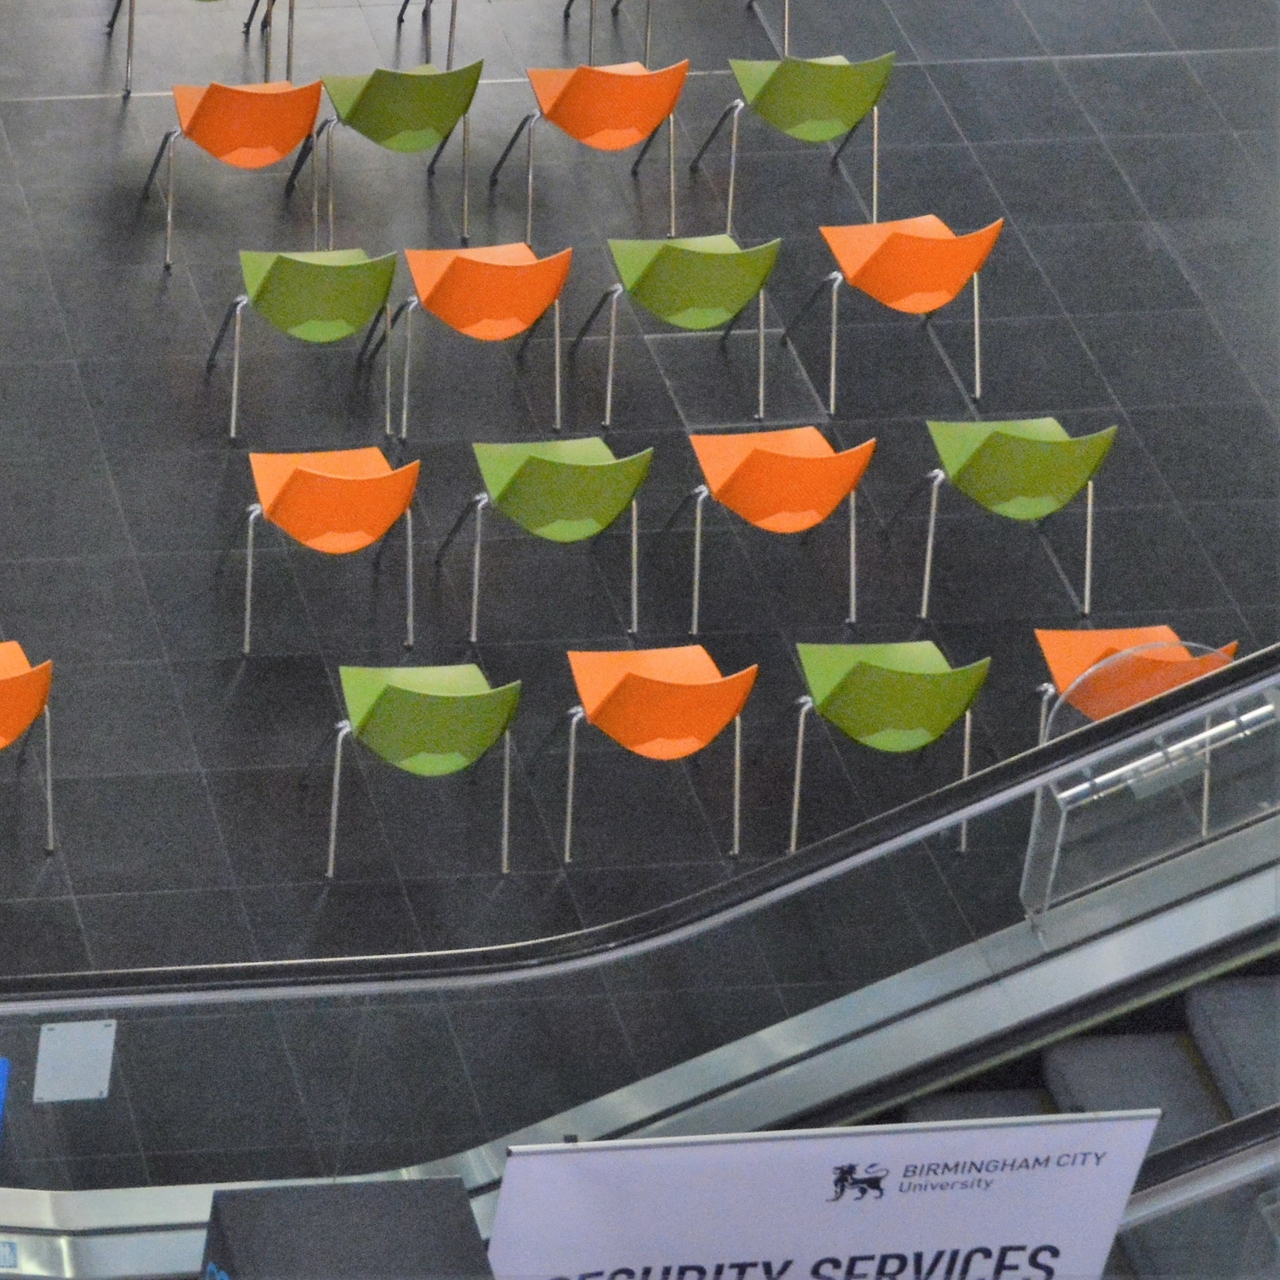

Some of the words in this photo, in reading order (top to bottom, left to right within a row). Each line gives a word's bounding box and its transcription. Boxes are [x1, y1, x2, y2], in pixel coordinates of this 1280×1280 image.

[901, 1154, 1052, 1179] BIRMINGHAM
[1055, 1151, 1108, 1169] CITY
[897, 1177, 995, 1195] University
